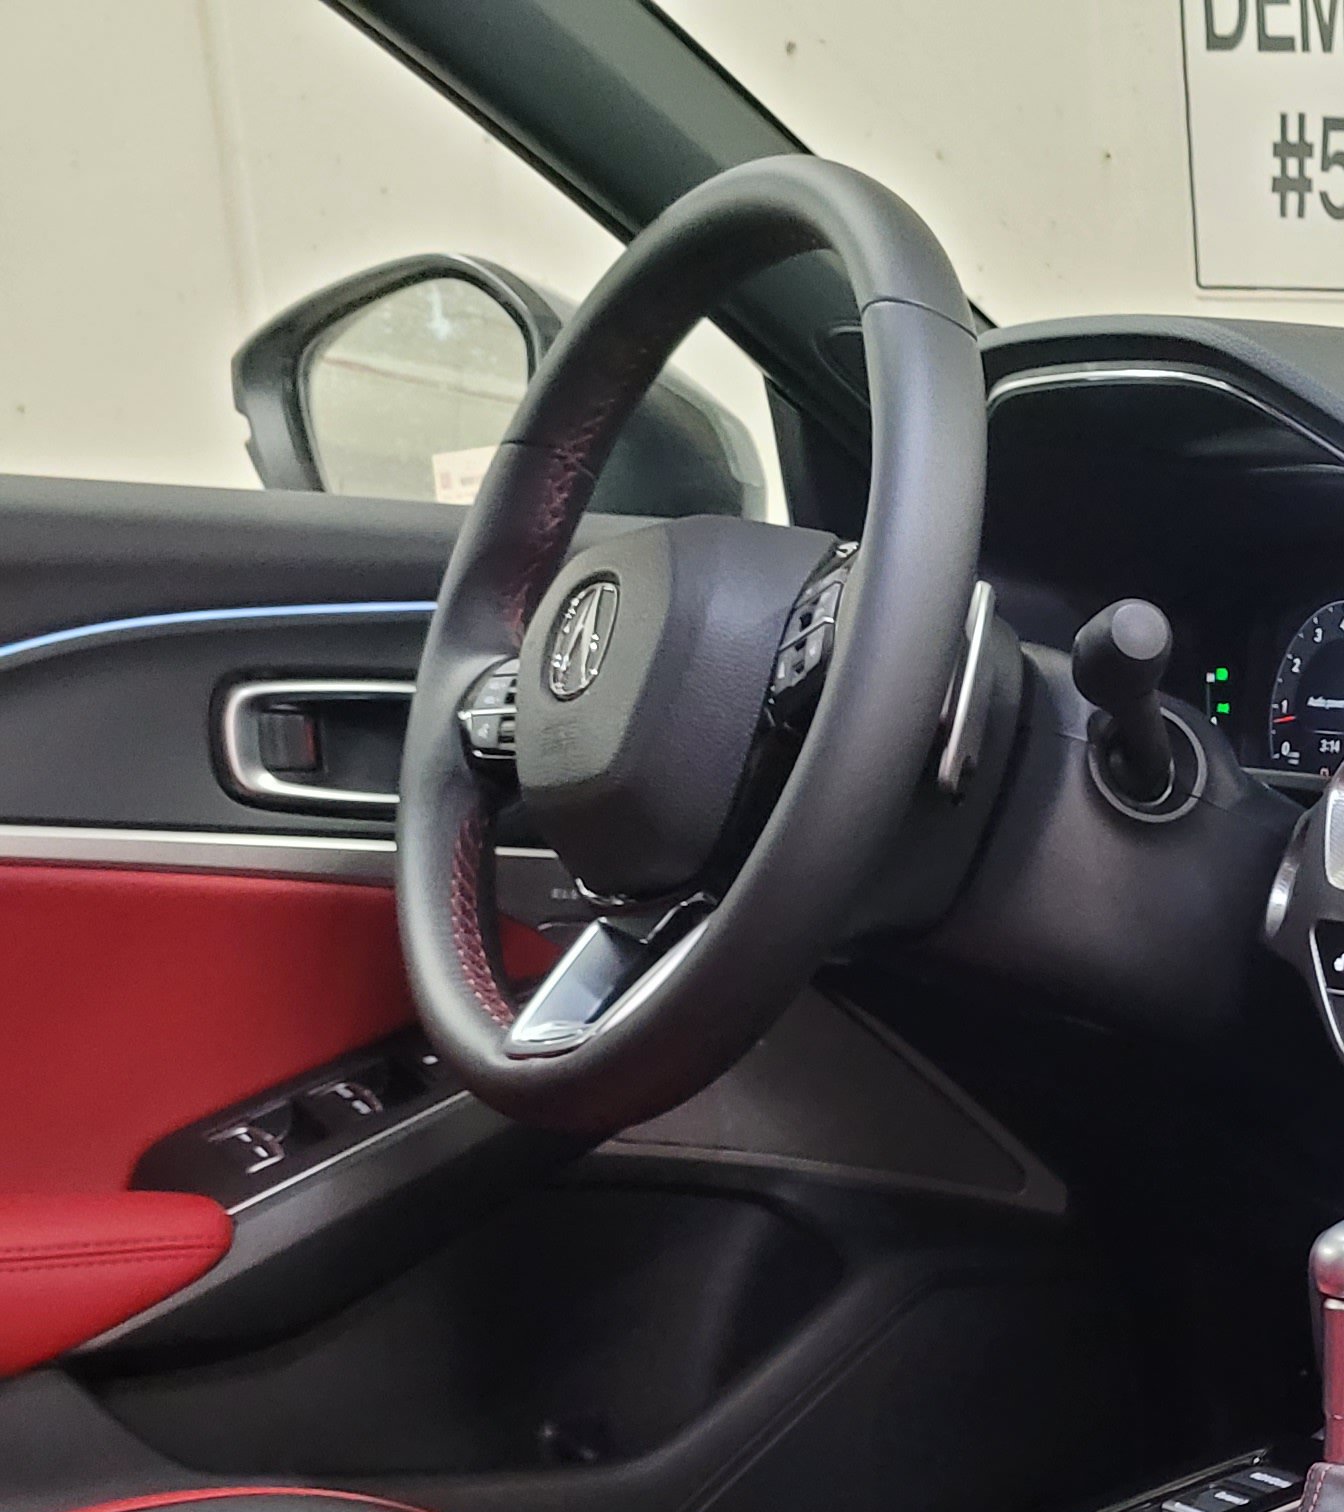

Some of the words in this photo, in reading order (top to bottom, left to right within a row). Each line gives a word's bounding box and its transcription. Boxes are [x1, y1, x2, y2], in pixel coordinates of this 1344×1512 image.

[1313, 627, 1323, 644] 3
[1291, 658, 1301, 674] 2
[1281, 699, 1289, 714] 1
[1281, 741, 1290, 757] 0
[1319, 738, 1341, 754] 3:14
